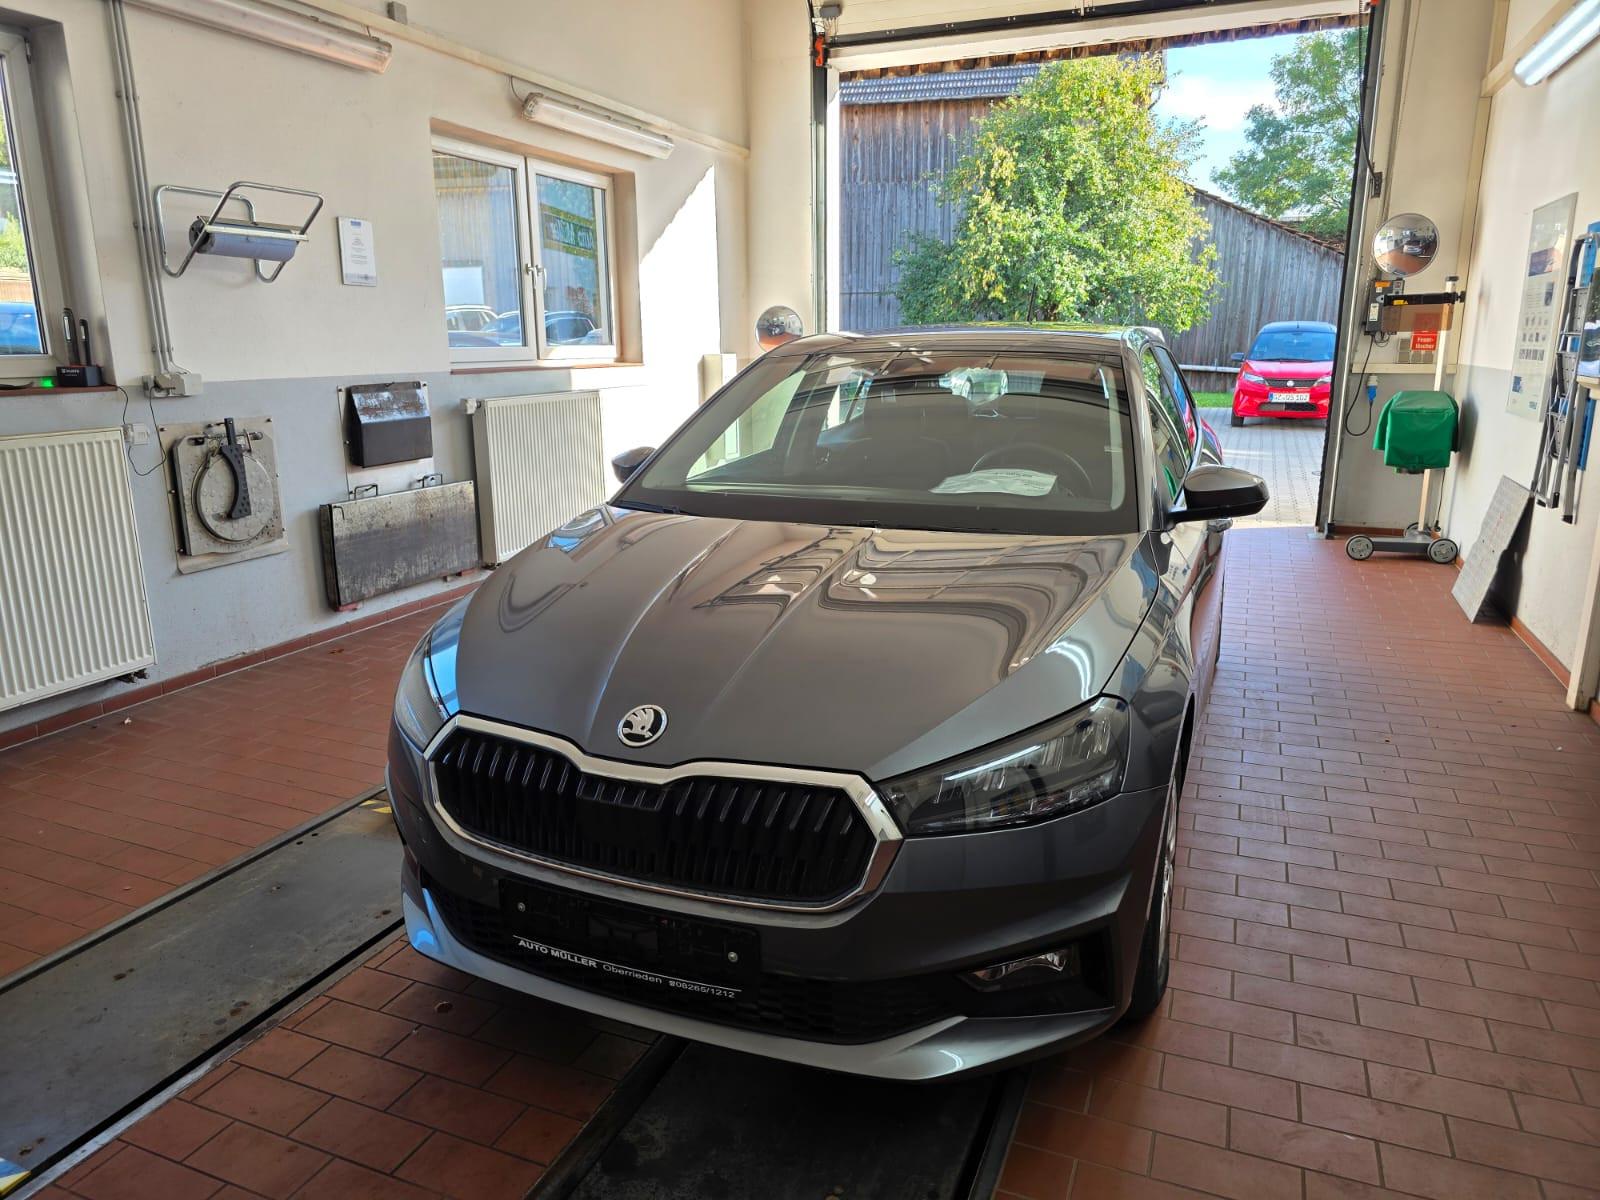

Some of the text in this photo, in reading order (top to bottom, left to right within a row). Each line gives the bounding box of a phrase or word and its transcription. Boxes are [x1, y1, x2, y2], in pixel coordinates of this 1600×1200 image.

[518, 940, 549, 954] AUTO
[550, 949, 598, 969] MÜLLER
[602, 964, 663, 984] Oberrieden
